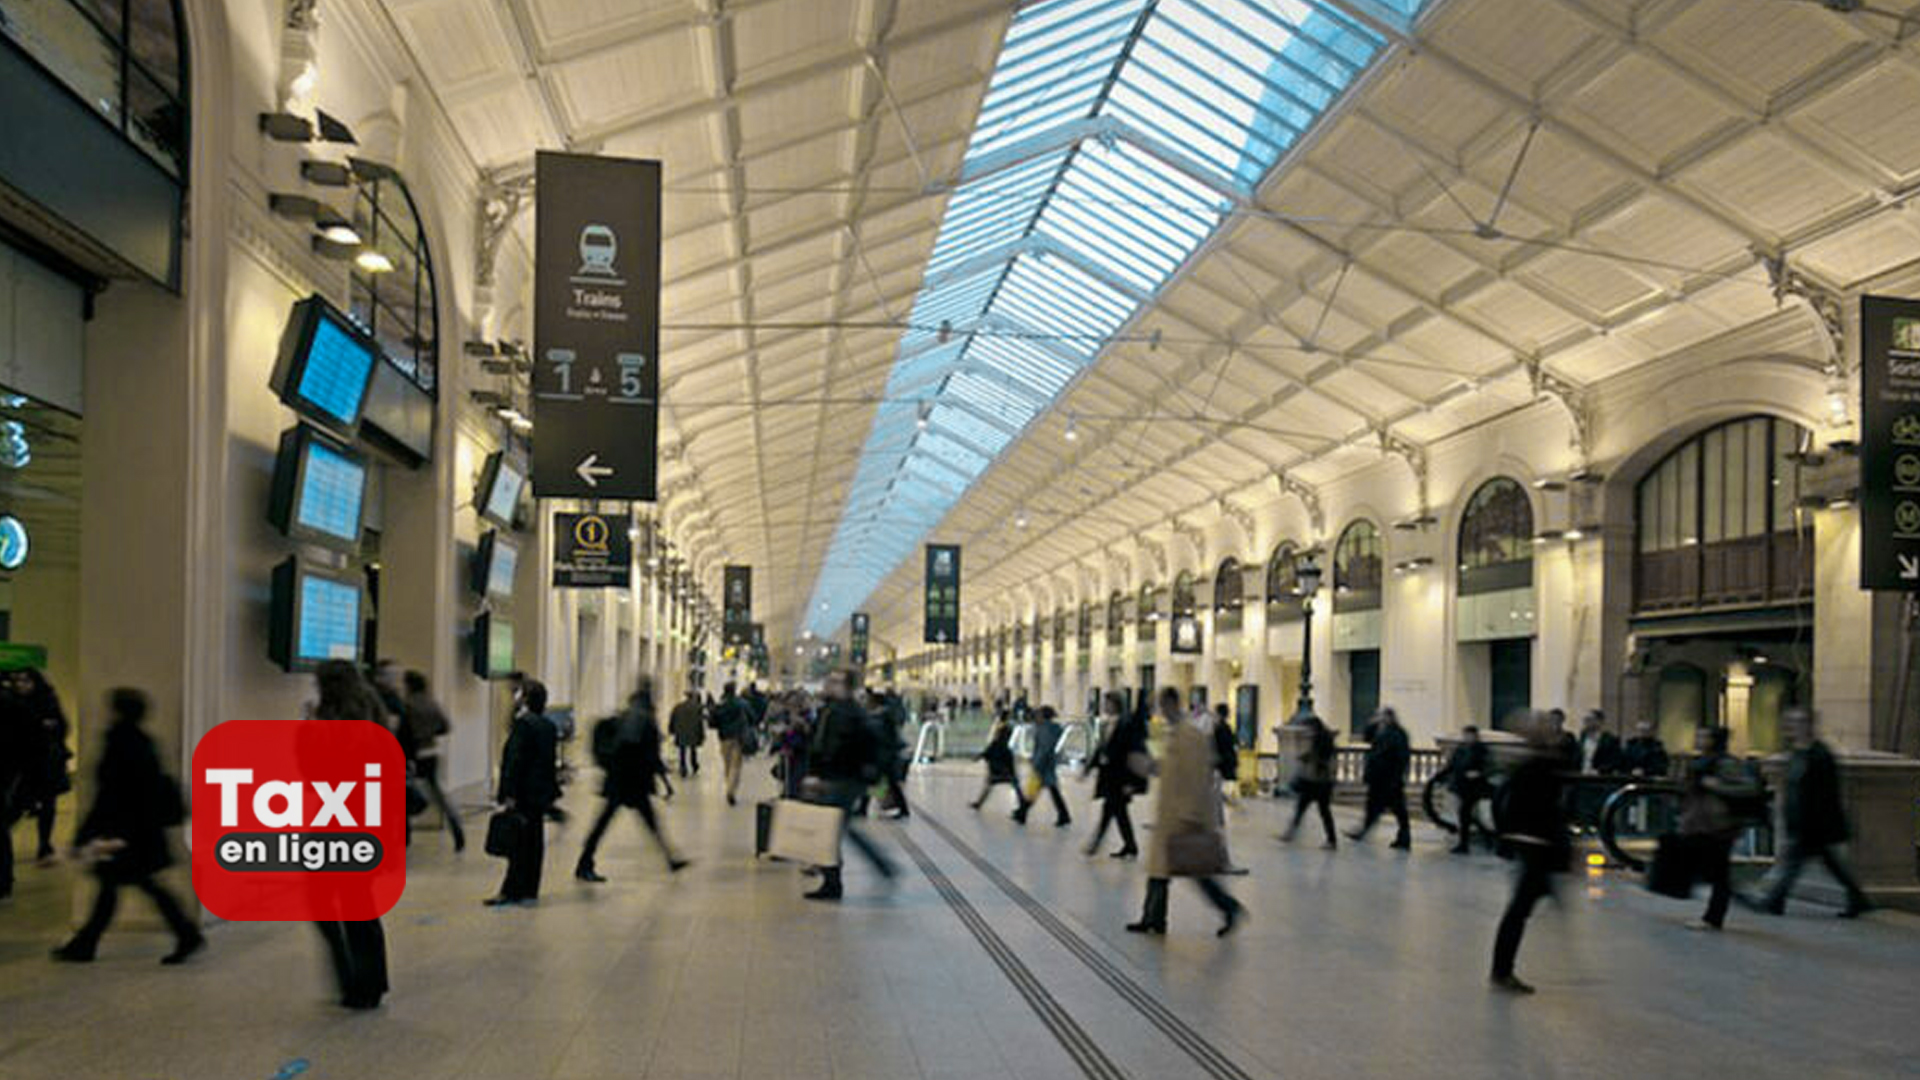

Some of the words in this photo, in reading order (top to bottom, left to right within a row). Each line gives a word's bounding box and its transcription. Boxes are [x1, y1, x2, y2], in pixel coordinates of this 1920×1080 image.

[572, 288, 622, 309] Trains
[553, 362, 571, 393] 1
[621, 366, 641, 397] 5
